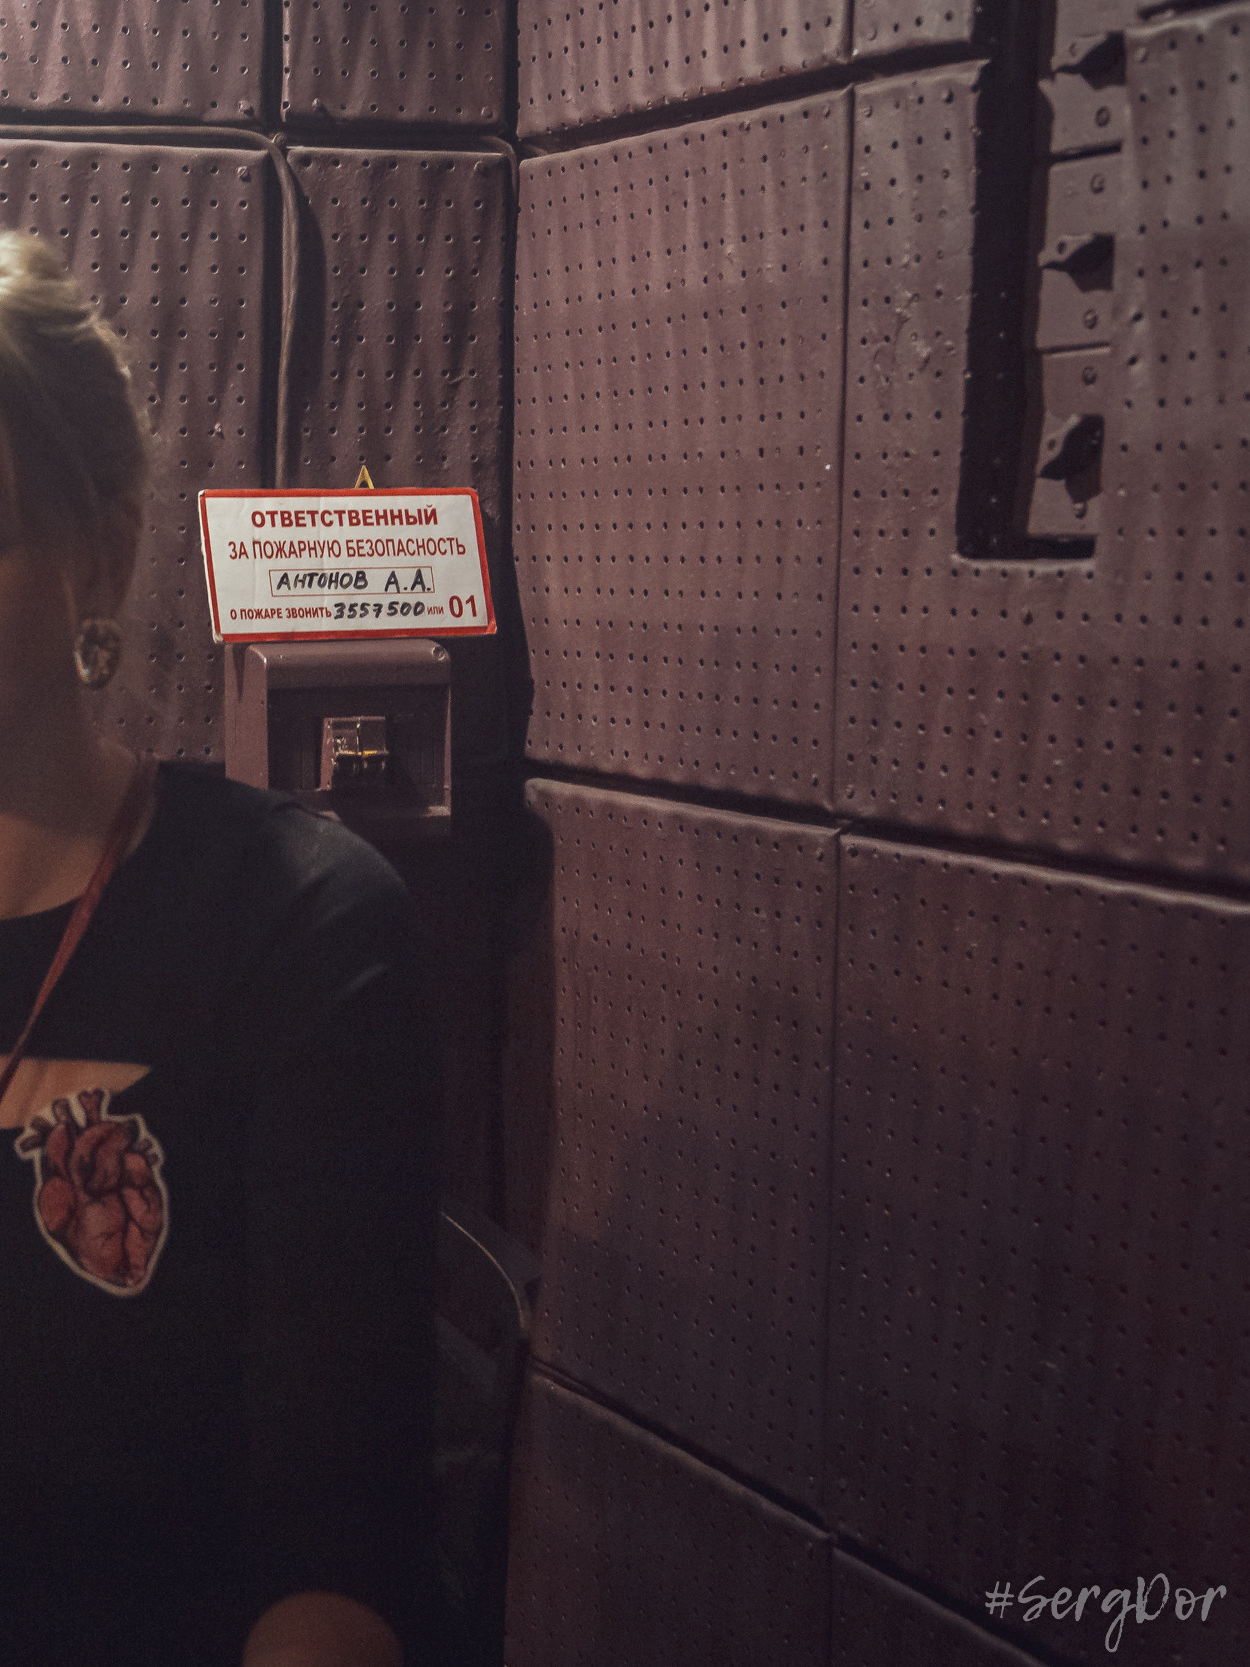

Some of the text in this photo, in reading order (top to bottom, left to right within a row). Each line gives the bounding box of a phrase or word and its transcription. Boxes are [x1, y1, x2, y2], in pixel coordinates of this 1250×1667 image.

[251, 504, 438, 528] ОТВЕТСТВЕННЫЙ
[228, 537, 466, 560] ЗА ПОЖАРНУЮ БЕЗОПАСНОСТЬ
[276, 571, 369, 591] АНТОНОВ
[230, 608, 237, 620] О
[240, 607, 283, 620] ПОЖАРЕ
[285, 606, 332, 619] ЗВОНИТЬ
[449, 595, 478, 618] 01
